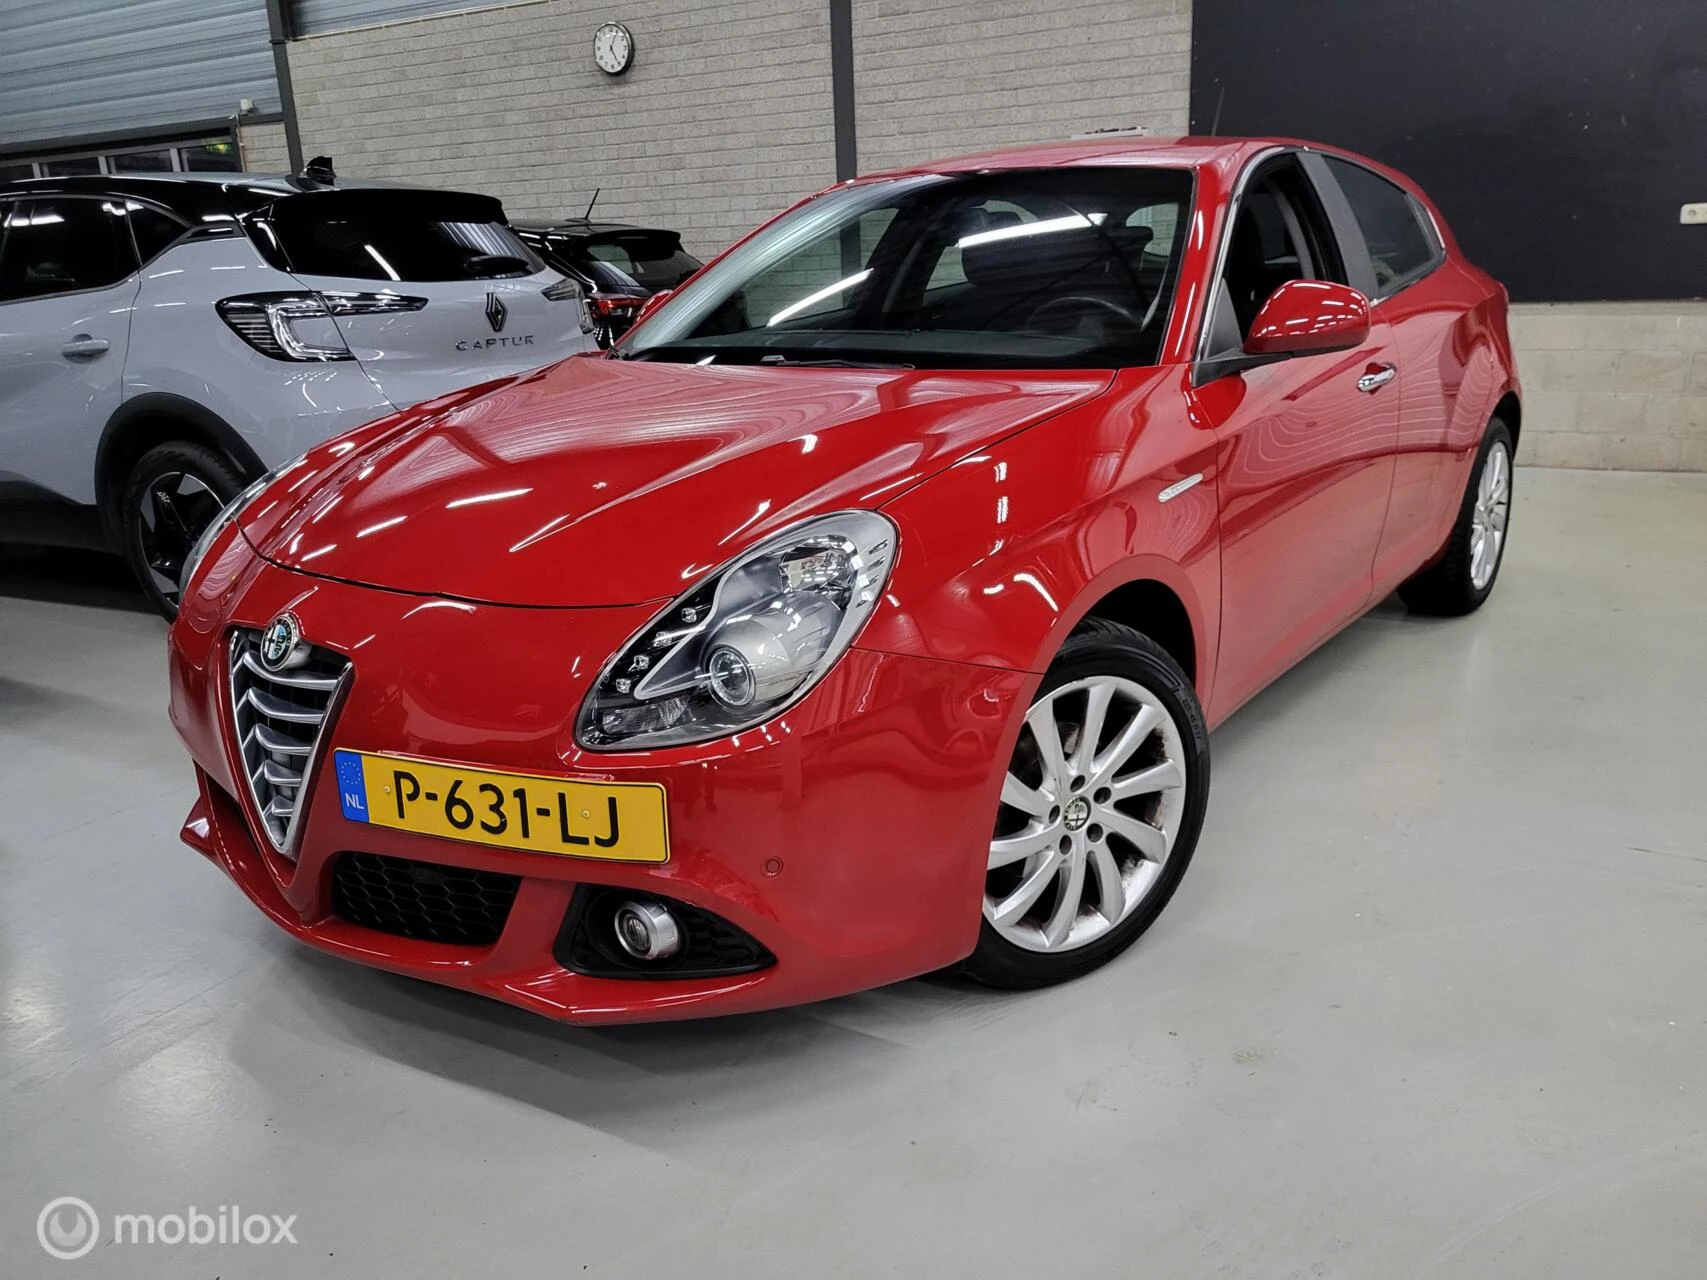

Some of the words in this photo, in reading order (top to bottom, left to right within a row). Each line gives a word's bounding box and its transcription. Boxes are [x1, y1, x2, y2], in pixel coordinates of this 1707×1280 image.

[455, 335, 534, 351] CAPTUR
[345, 793, 364, 810] NL
[393, 770, 620, 848] P-631-LJ
